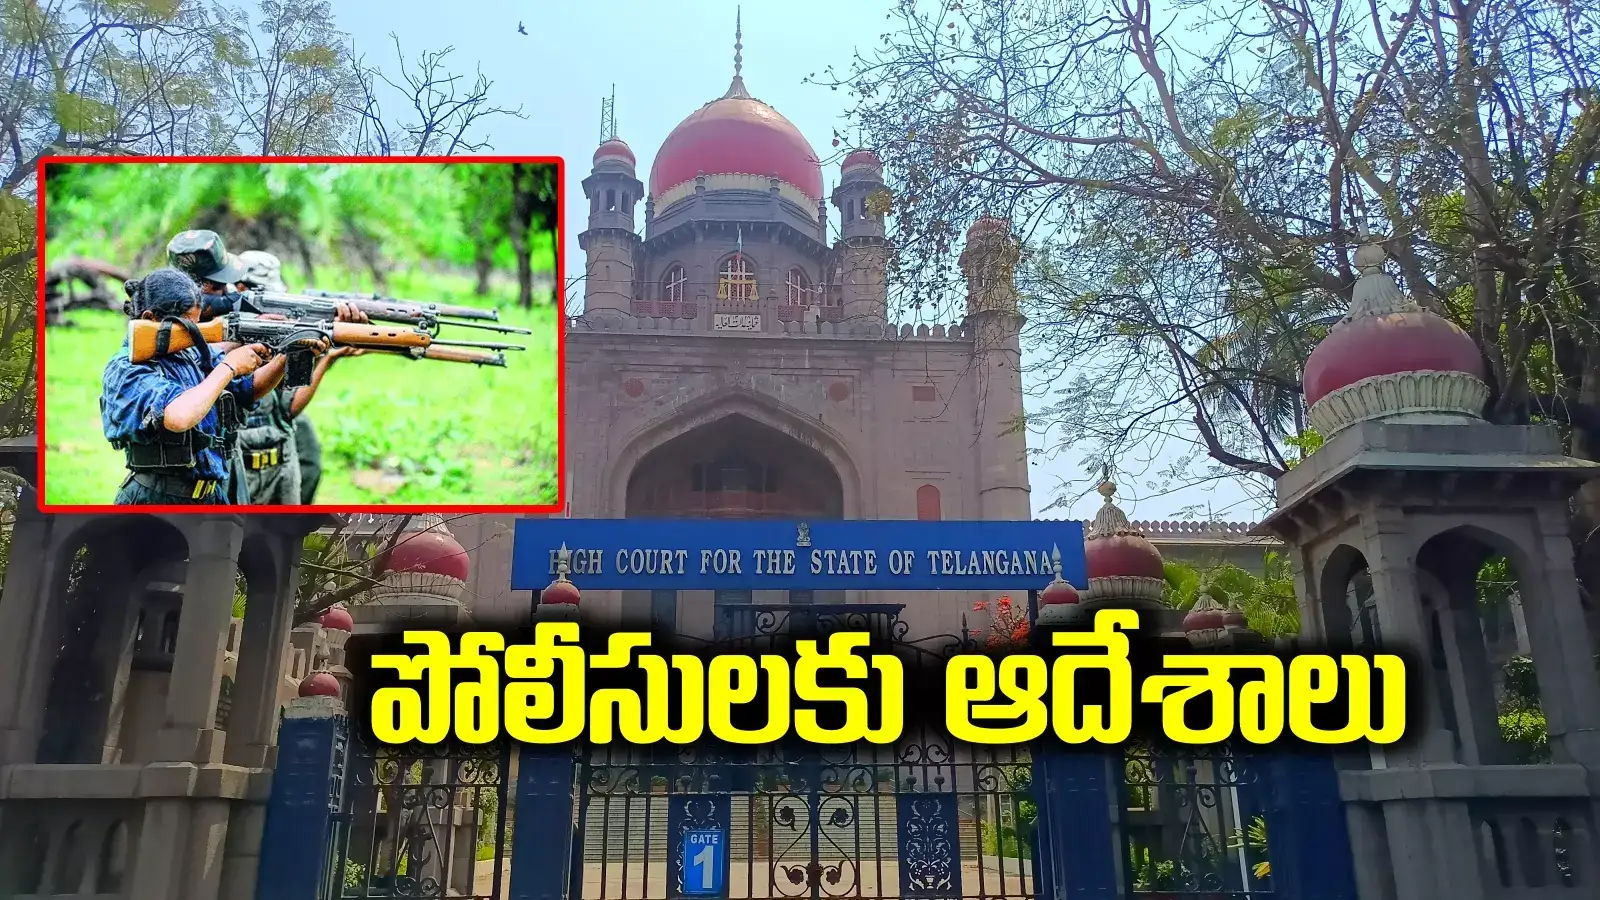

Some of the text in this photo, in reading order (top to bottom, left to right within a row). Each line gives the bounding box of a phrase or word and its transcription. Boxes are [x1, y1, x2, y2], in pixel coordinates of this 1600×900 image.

[549, 549, 1054, 575] HIGH COURT FOR THE STATE OF TELANGANA
[690, 834, 719, 844] GATE
[693, 845, 714, 889] 1
